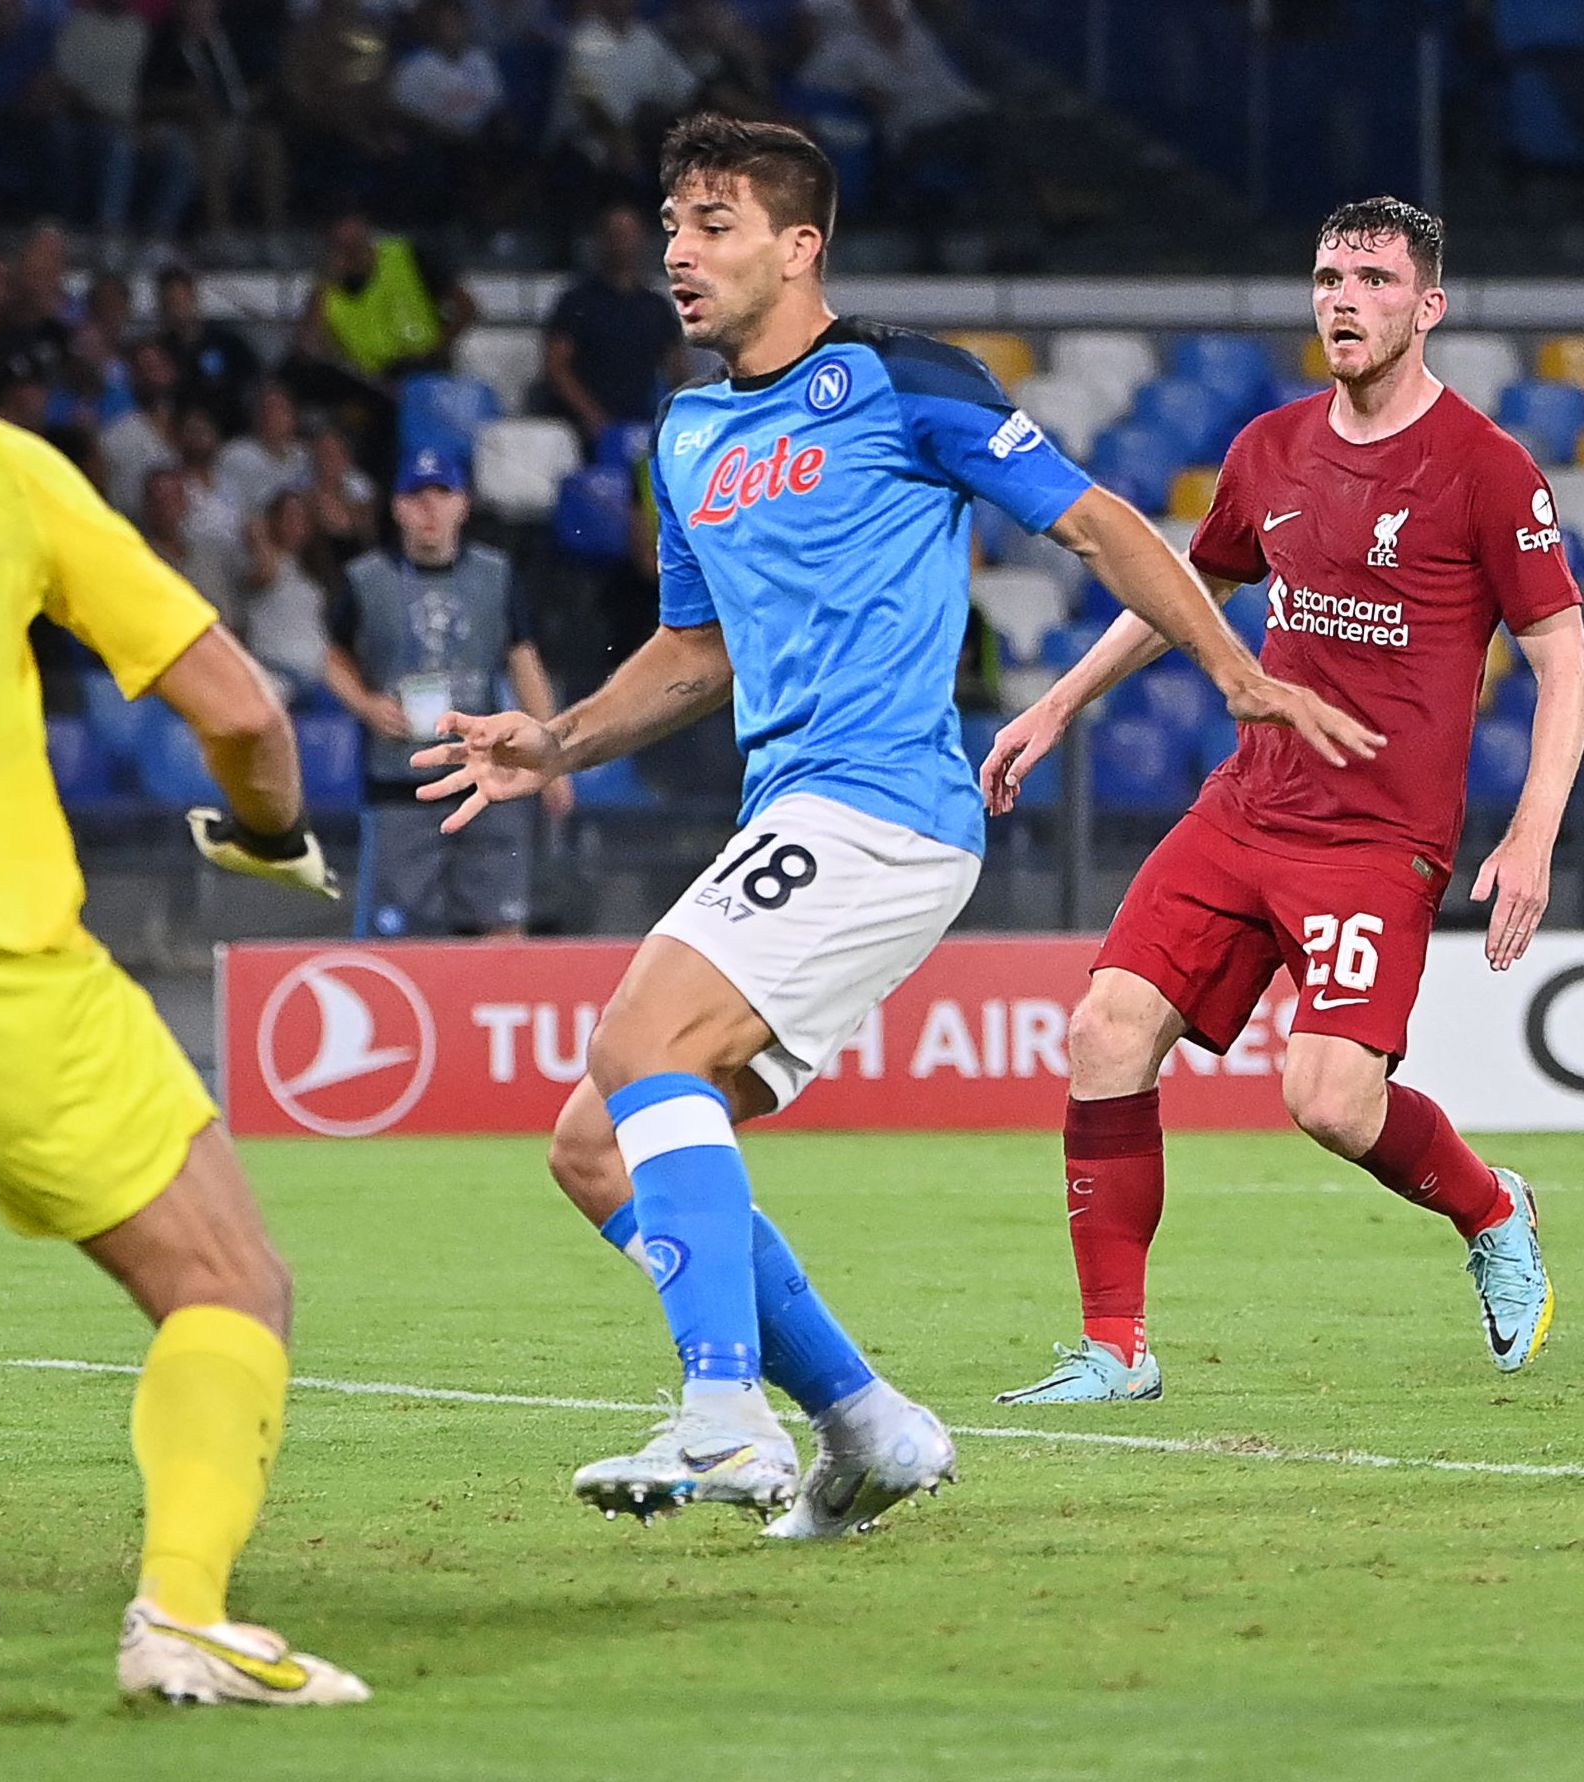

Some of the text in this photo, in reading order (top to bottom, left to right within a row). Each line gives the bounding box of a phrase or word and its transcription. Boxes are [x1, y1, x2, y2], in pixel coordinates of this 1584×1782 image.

[688, 435, 826, 530] Lete
[1289, 609, 1409, 647] chartered
[1292, 586, 1403, 625] standard
[713, 832, 817, 910] 18
[694, 887, 756, 923] EA7
[1302, 912, 1384, 992] 26
